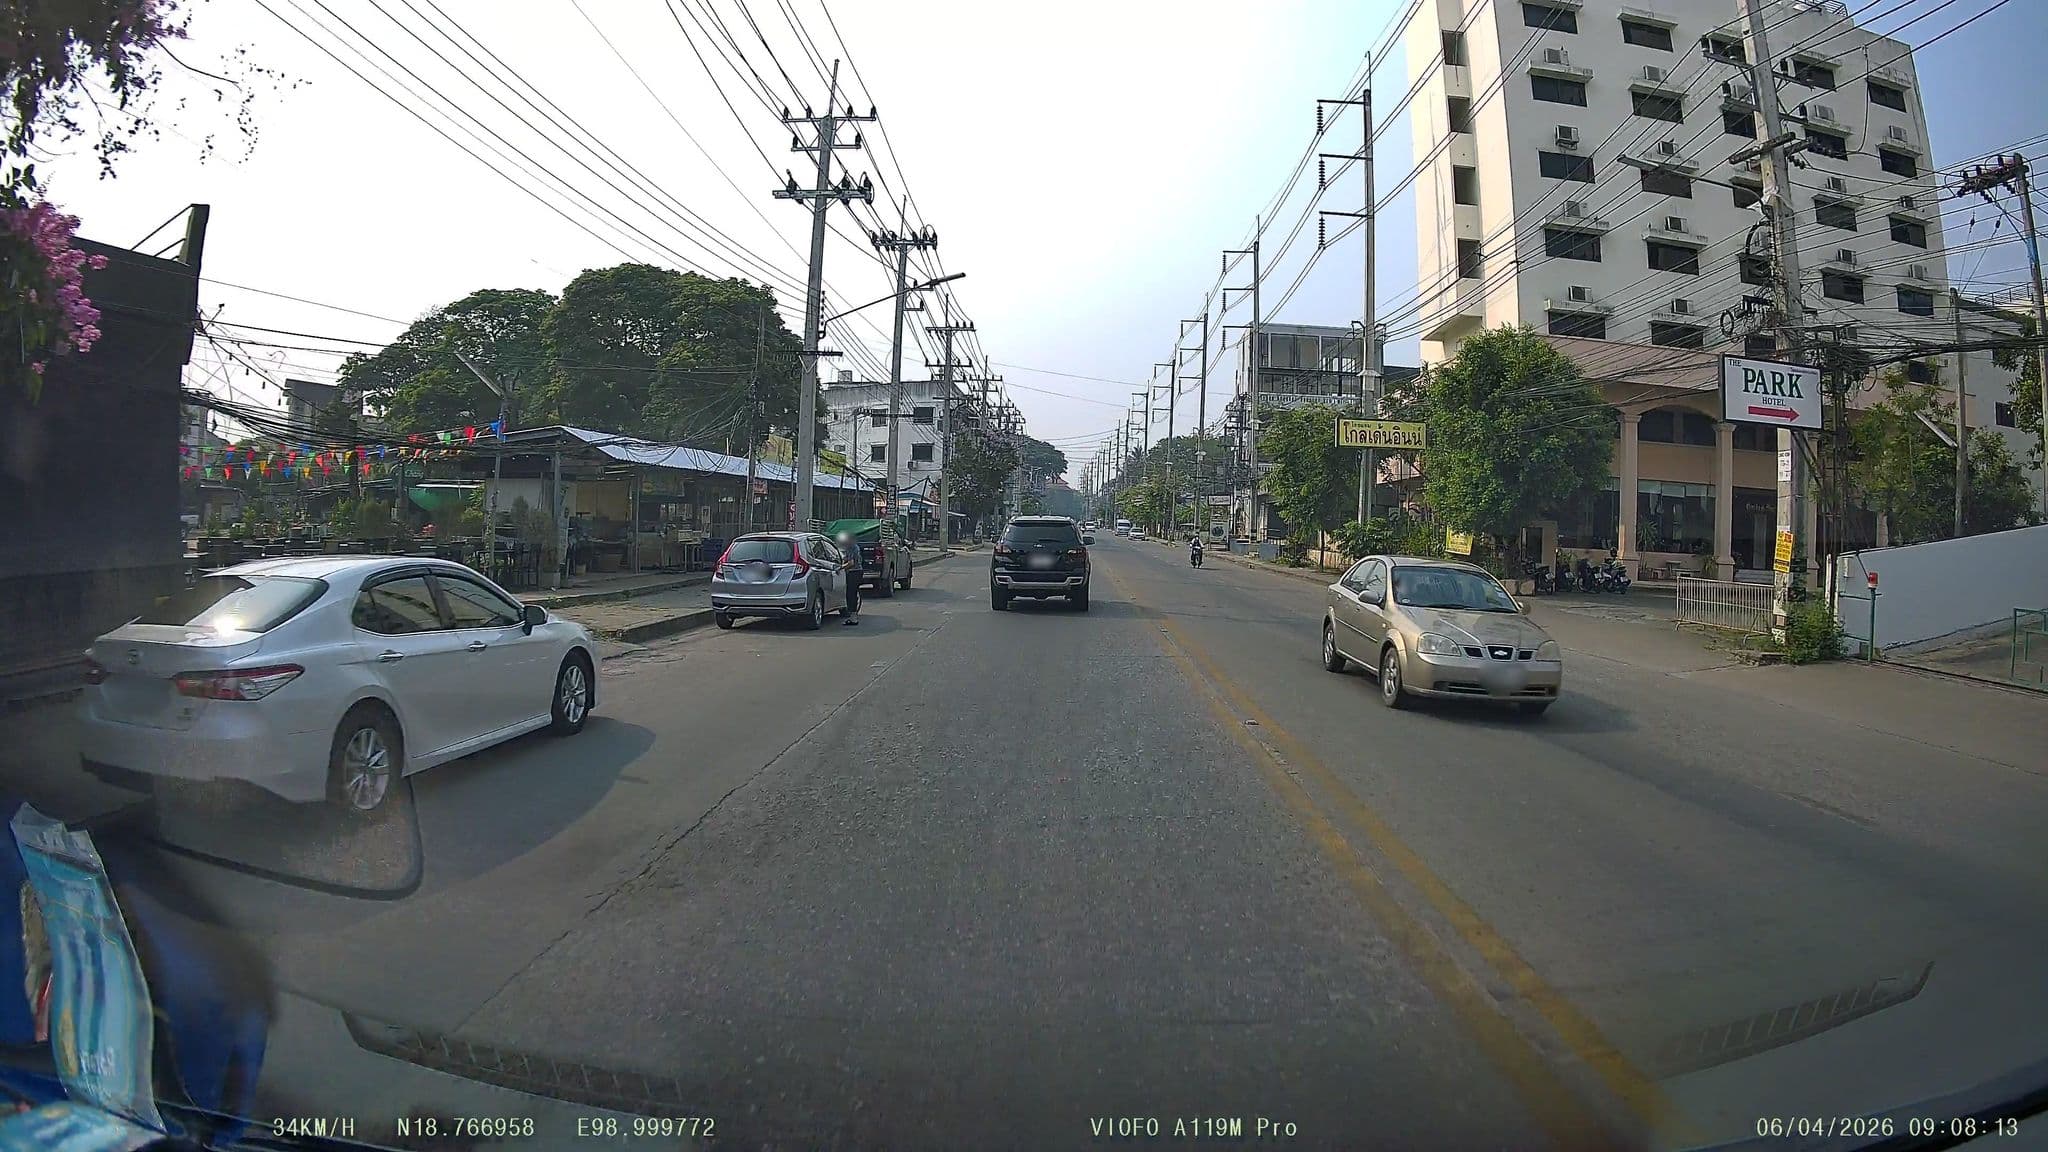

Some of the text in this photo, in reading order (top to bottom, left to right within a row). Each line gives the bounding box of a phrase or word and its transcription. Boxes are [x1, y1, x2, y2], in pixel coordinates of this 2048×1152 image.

[1728, 359, 1742, 367] THE
[1742, 367, 1804, 399] PARK
[1762, 396, 1786, 407] HOTEL
[1343, 421, 1423, 446] โกลเด้นอินน์
